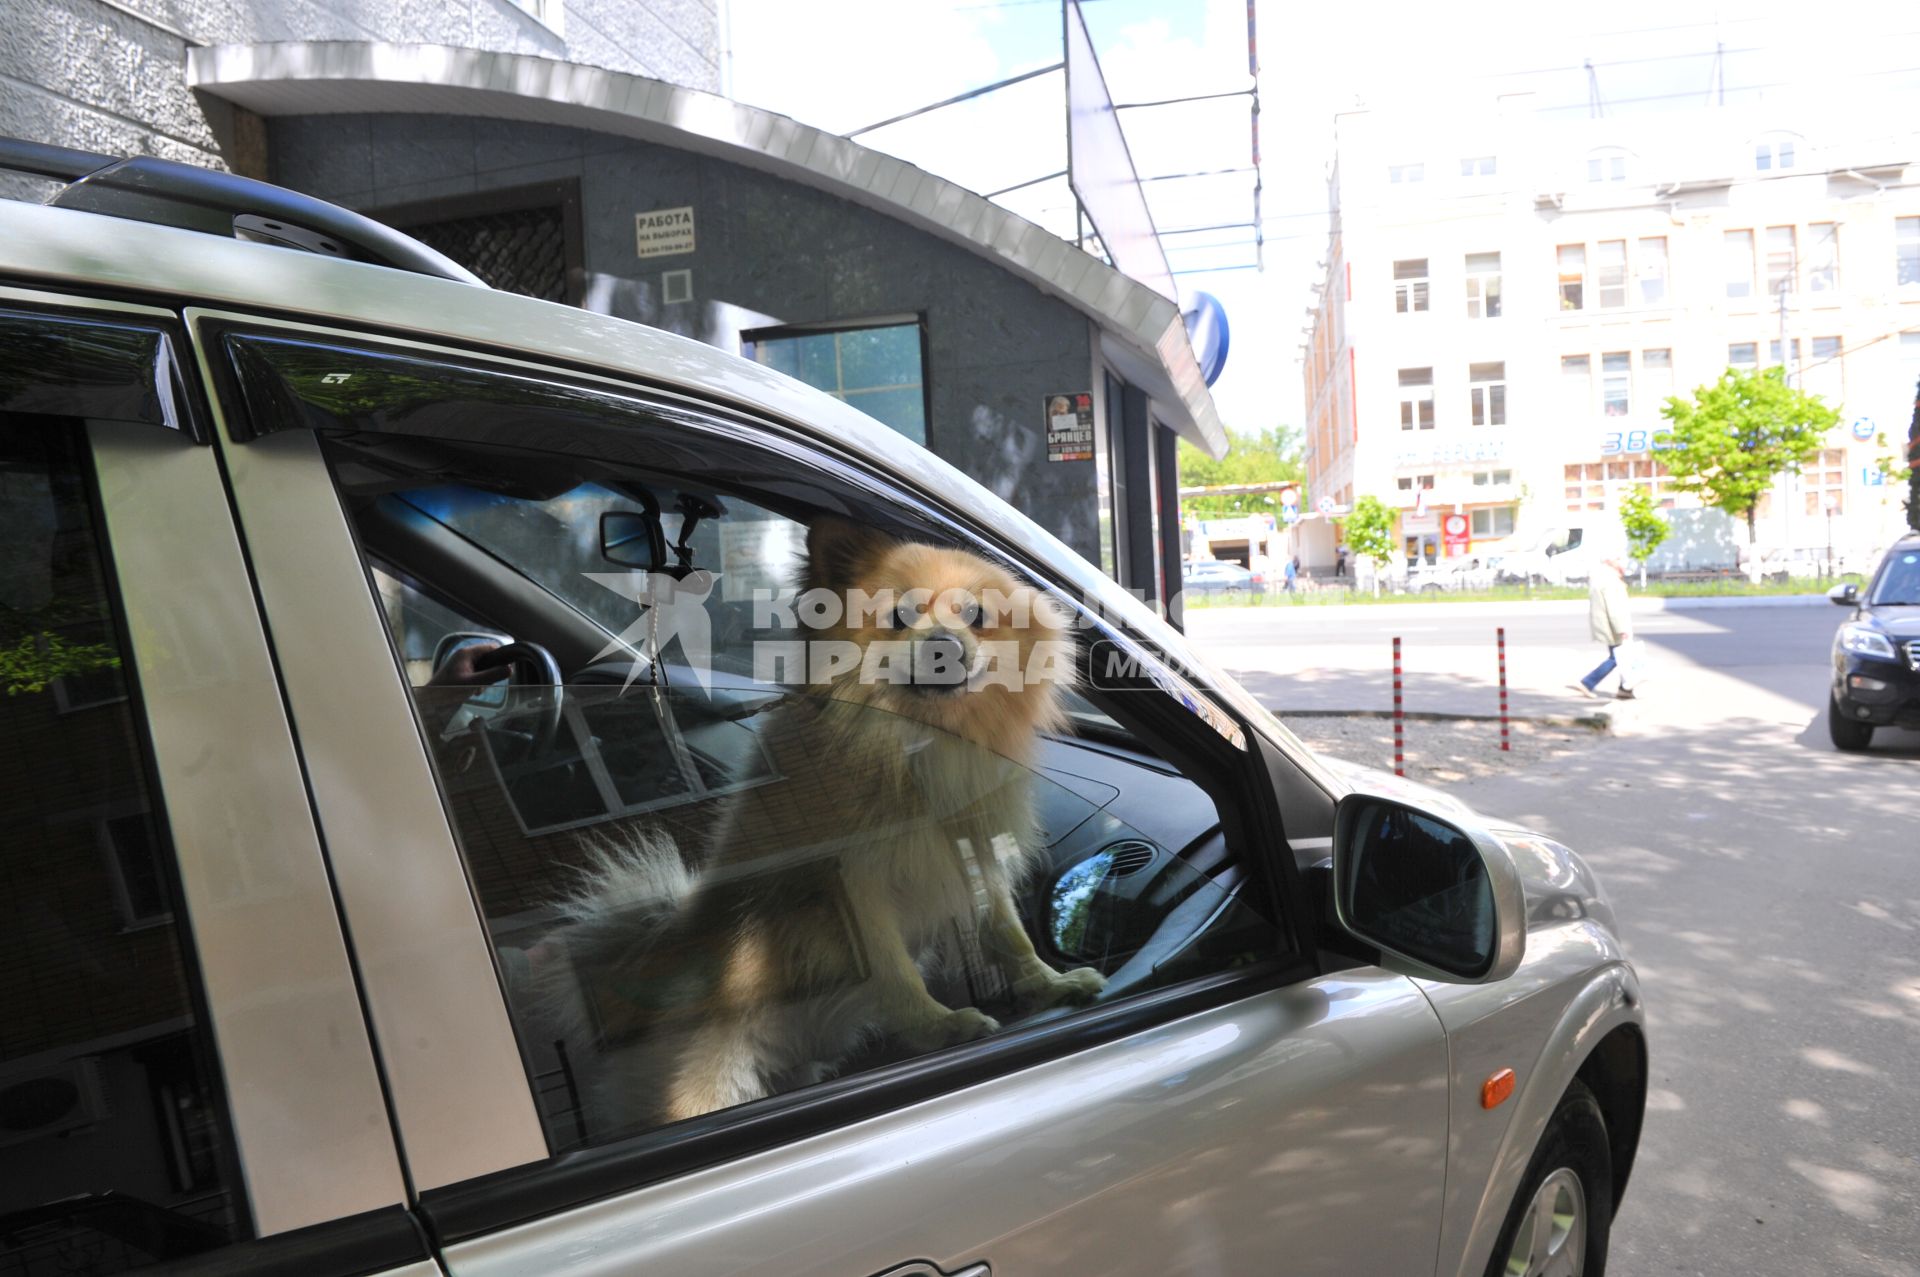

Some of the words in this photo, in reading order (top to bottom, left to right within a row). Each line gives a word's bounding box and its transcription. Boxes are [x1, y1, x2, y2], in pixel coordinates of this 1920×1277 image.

[639, 212, 690, 229] РАБОТА
[653, 229, 692, 239] ВЫБОРАХ
[1048, 431, 1092, 443] БРЯНЦЕВ
